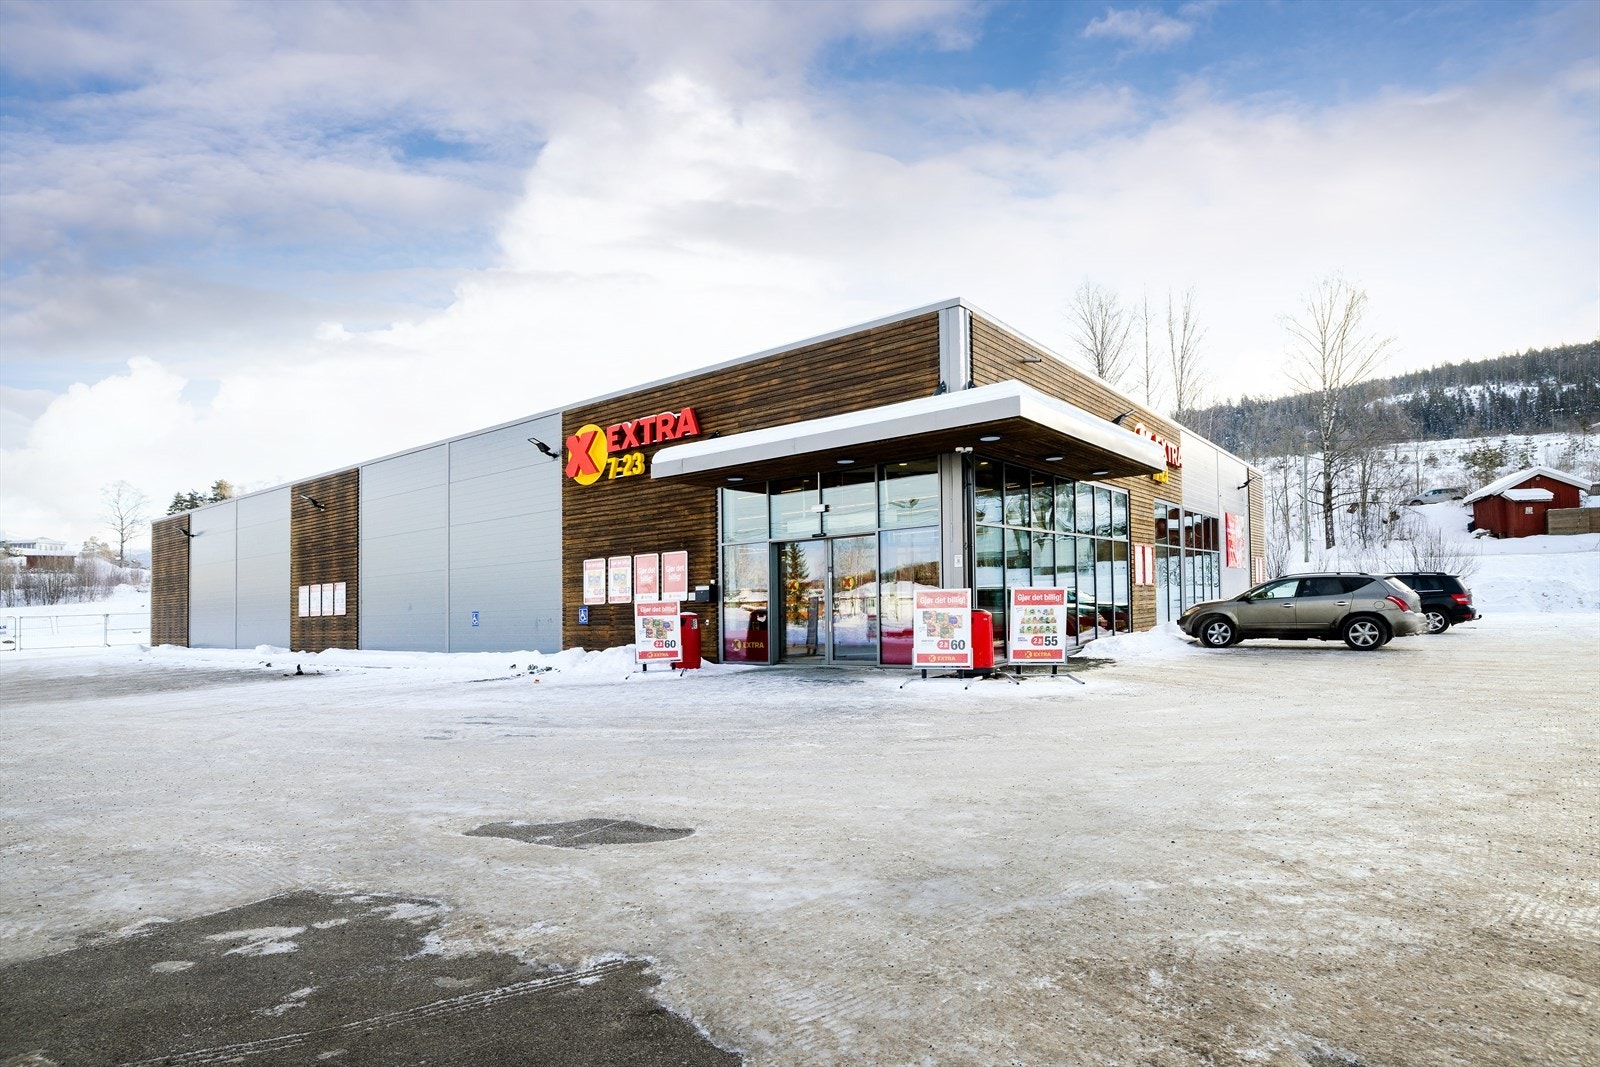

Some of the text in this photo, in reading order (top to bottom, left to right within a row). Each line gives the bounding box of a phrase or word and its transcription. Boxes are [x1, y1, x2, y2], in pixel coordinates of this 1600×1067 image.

[606, 407, 701, 453] EXTRA
[607, 452, 645, 480] 7-23
[920, 596, 966, 606] Gjør det billig!
[1017, 593, 1062, 602] Gjør det billig!
[664, 640, 676, 648] 60
[743, 641, 765, 649] EXTRA
[950, 639, 966, 650] 60
[1044, 635, 1058, 647] 55
